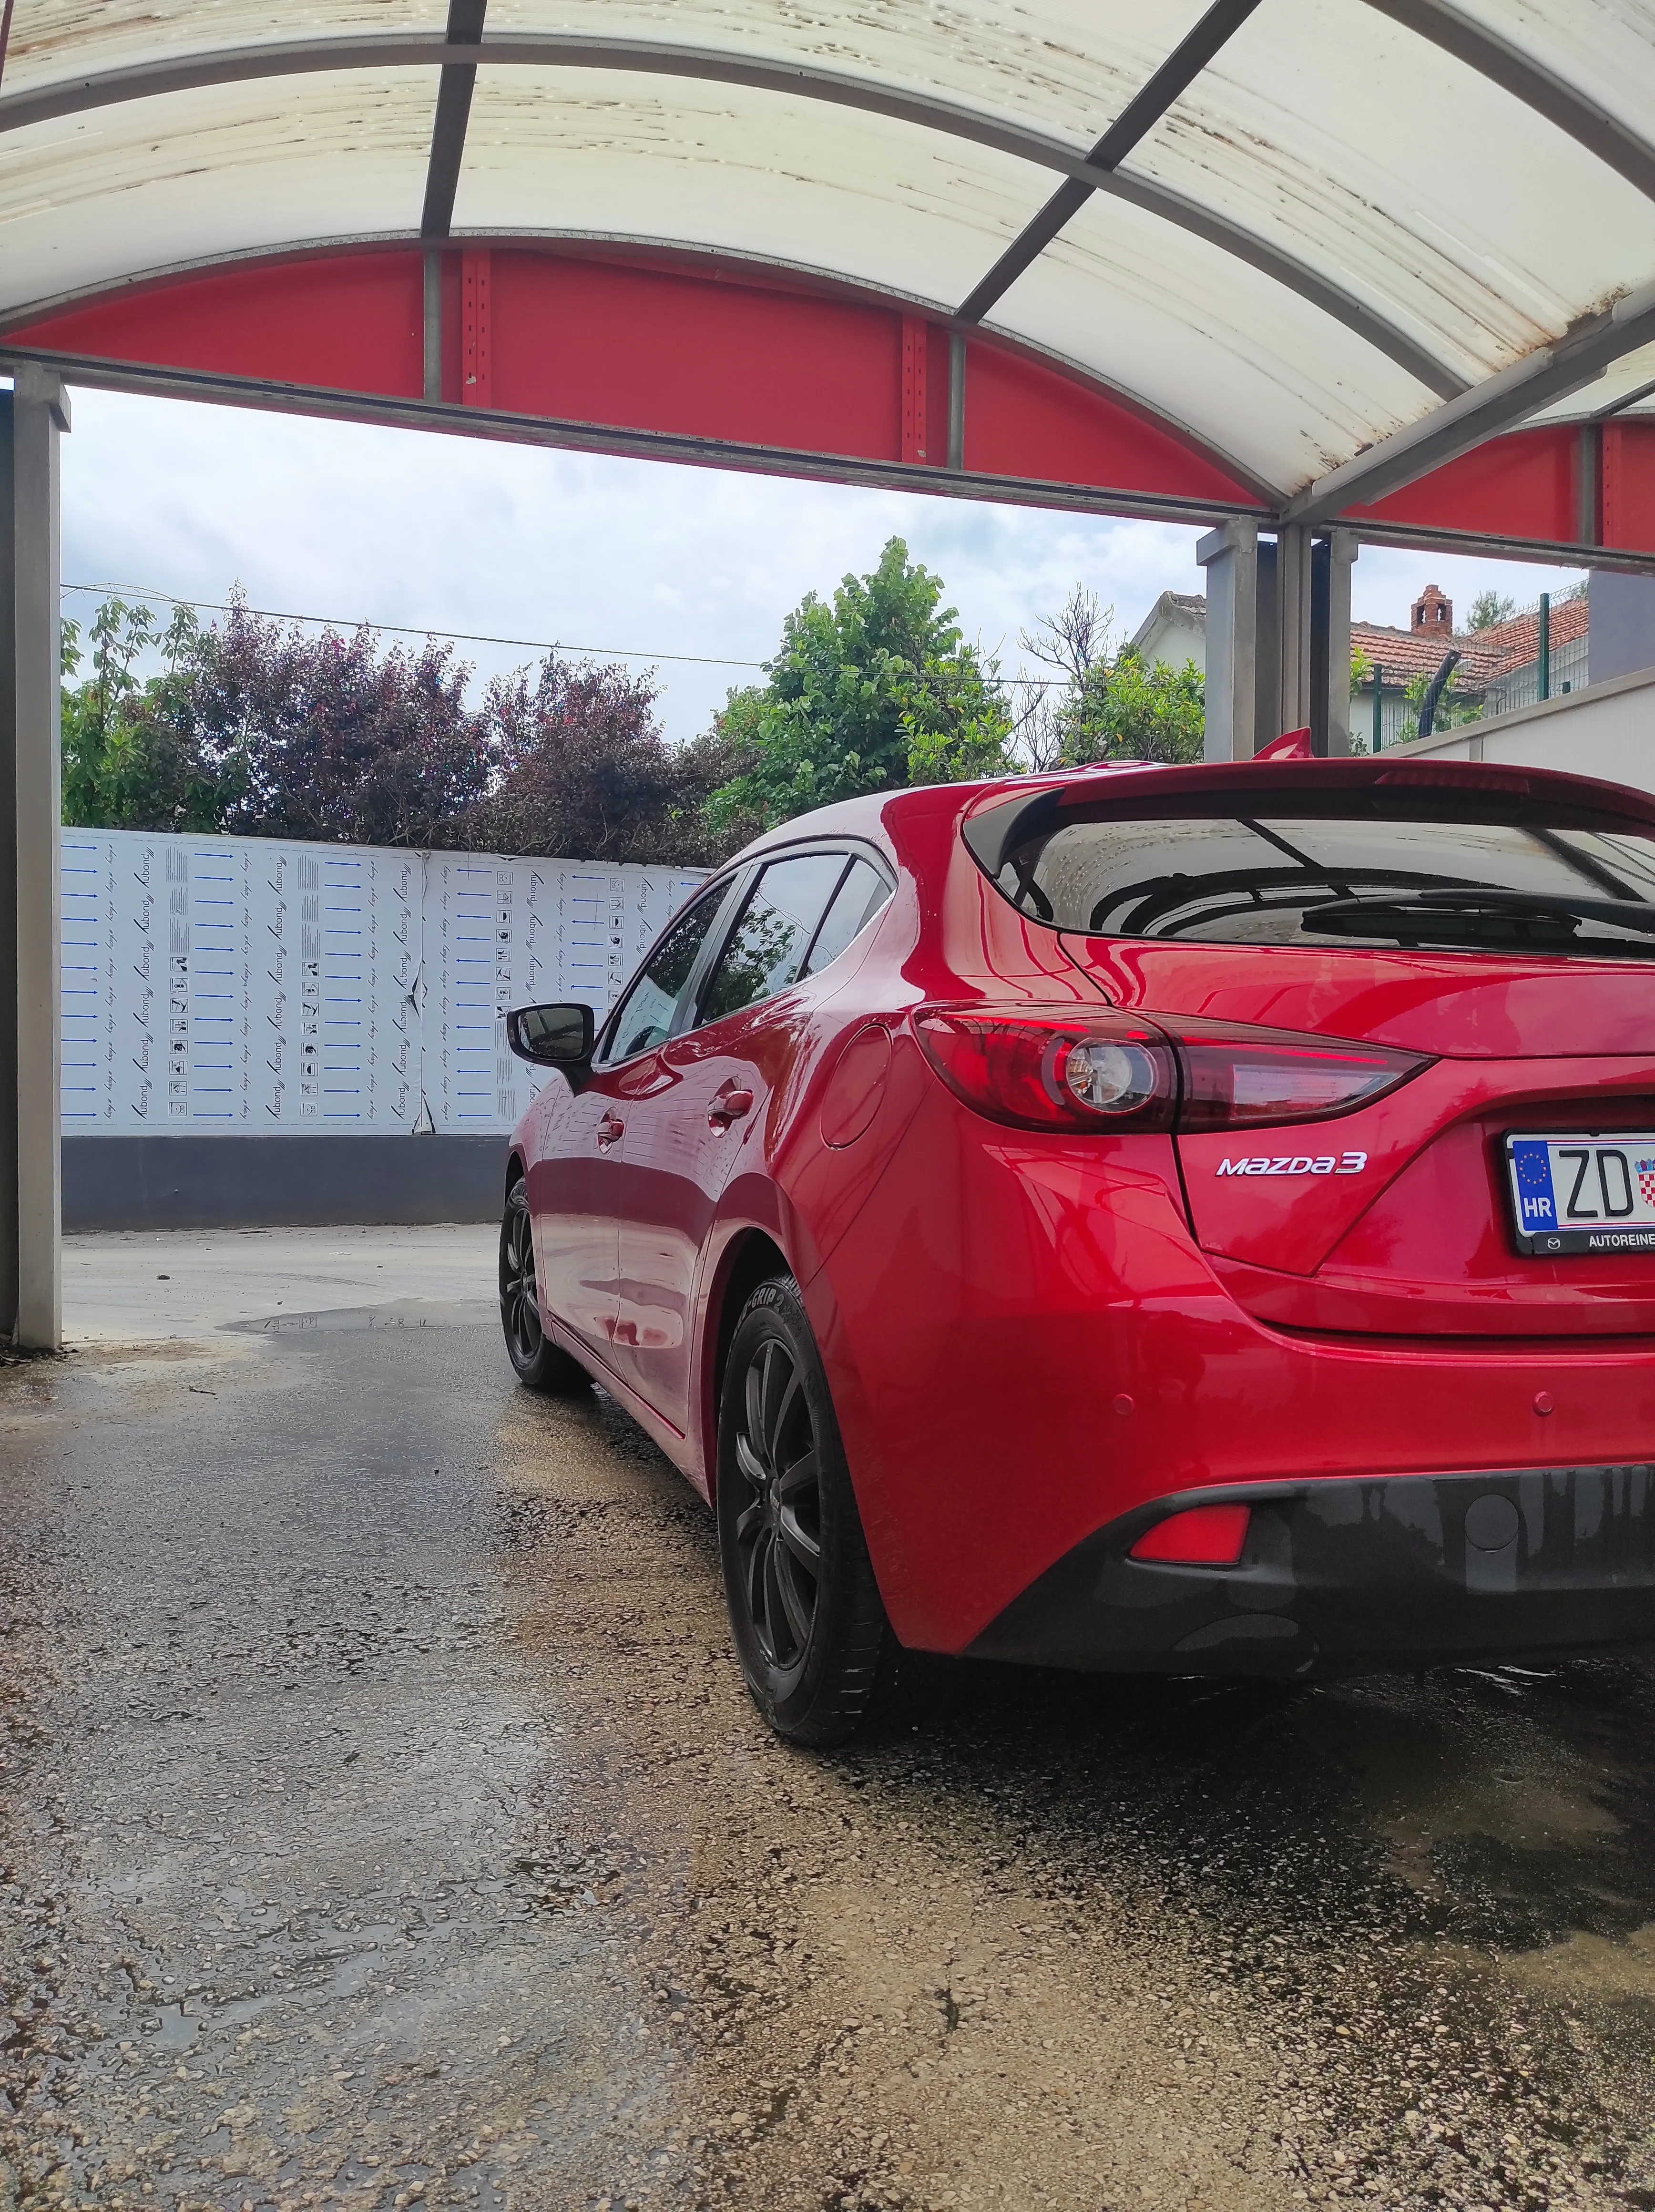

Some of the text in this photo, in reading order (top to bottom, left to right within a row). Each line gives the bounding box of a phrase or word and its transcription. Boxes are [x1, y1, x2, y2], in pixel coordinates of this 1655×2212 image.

[1558, 1149, 1634, 1219] ZD
[1524, 1197, 1552, 1218] HR
[774, 1294, 785, 1313] 2
